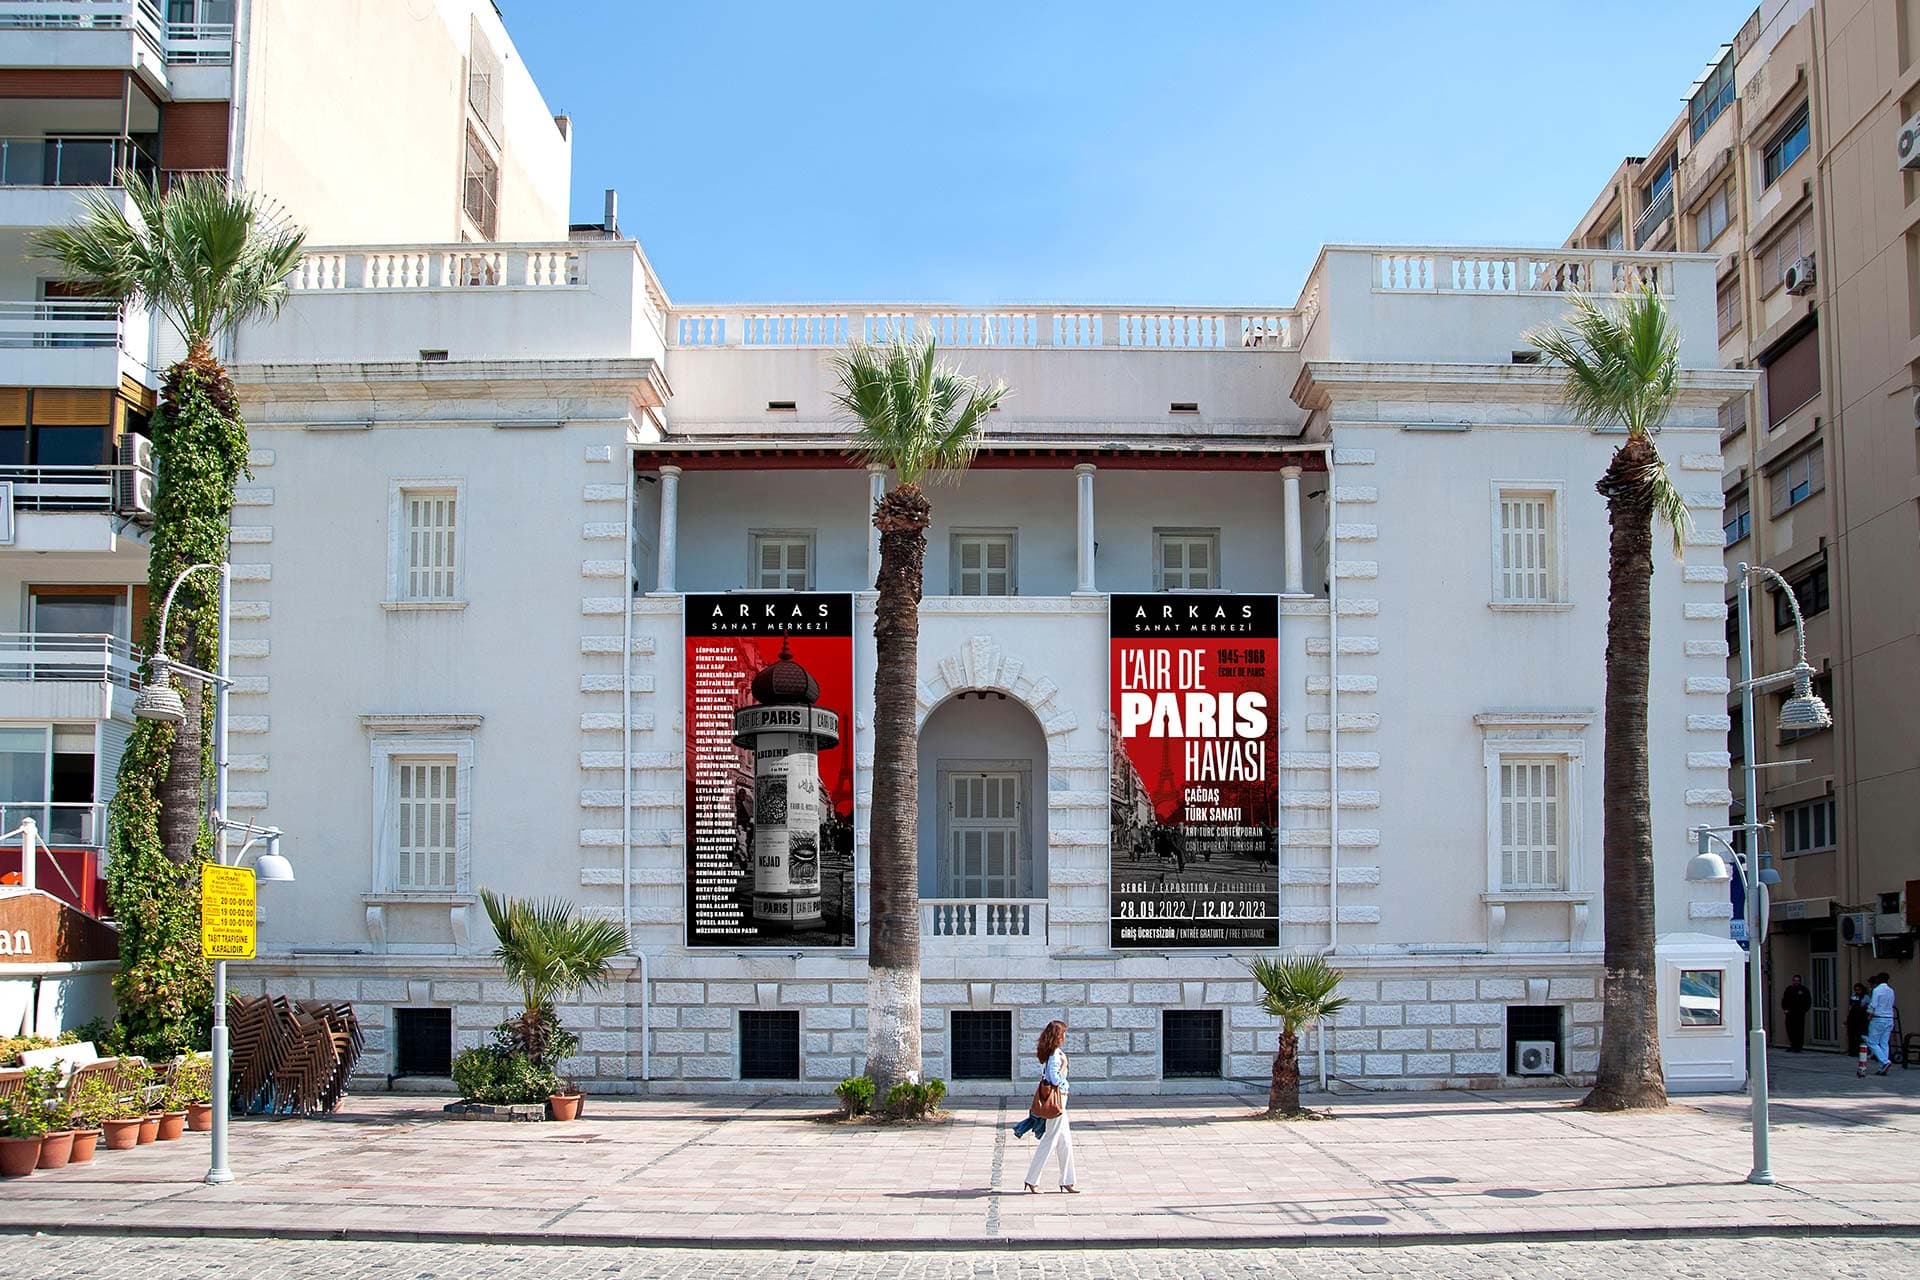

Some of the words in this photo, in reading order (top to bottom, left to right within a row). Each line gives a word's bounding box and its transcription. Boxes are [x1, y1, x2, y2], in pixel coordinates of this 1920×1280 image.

[712, 604, 828, 617] ARKAS
[1135, 605, 1252, 618] ARKAS
[767, 622, 828, 630] MERKEZİ
[1190, 623, 1252, 631] MERKEZİ
[1121, 648, 1171, 690] L'AIR
[1178, 648, 1206, 690] DE
[762, 711, 801, 725] PARIS
[1121, 691, 1268, 738] PARIS
[1185, 740, 1265, 781] HAVASI
[1184, 785, 1220, 806] ÇAĞDAŞ
[1184, 804, 1208, 821] TÜRK
[1209, 807, 1241, 821] SANATI
[759, 855, 780, 867] NEJAD
[1121, 881, 1146, 893] SERGİ
[1121, 901, 1186, 918] 28.09.2022
[1191, 900, 1197, 920] /
[1202, 901, 1266, 918] 12.02.2023
